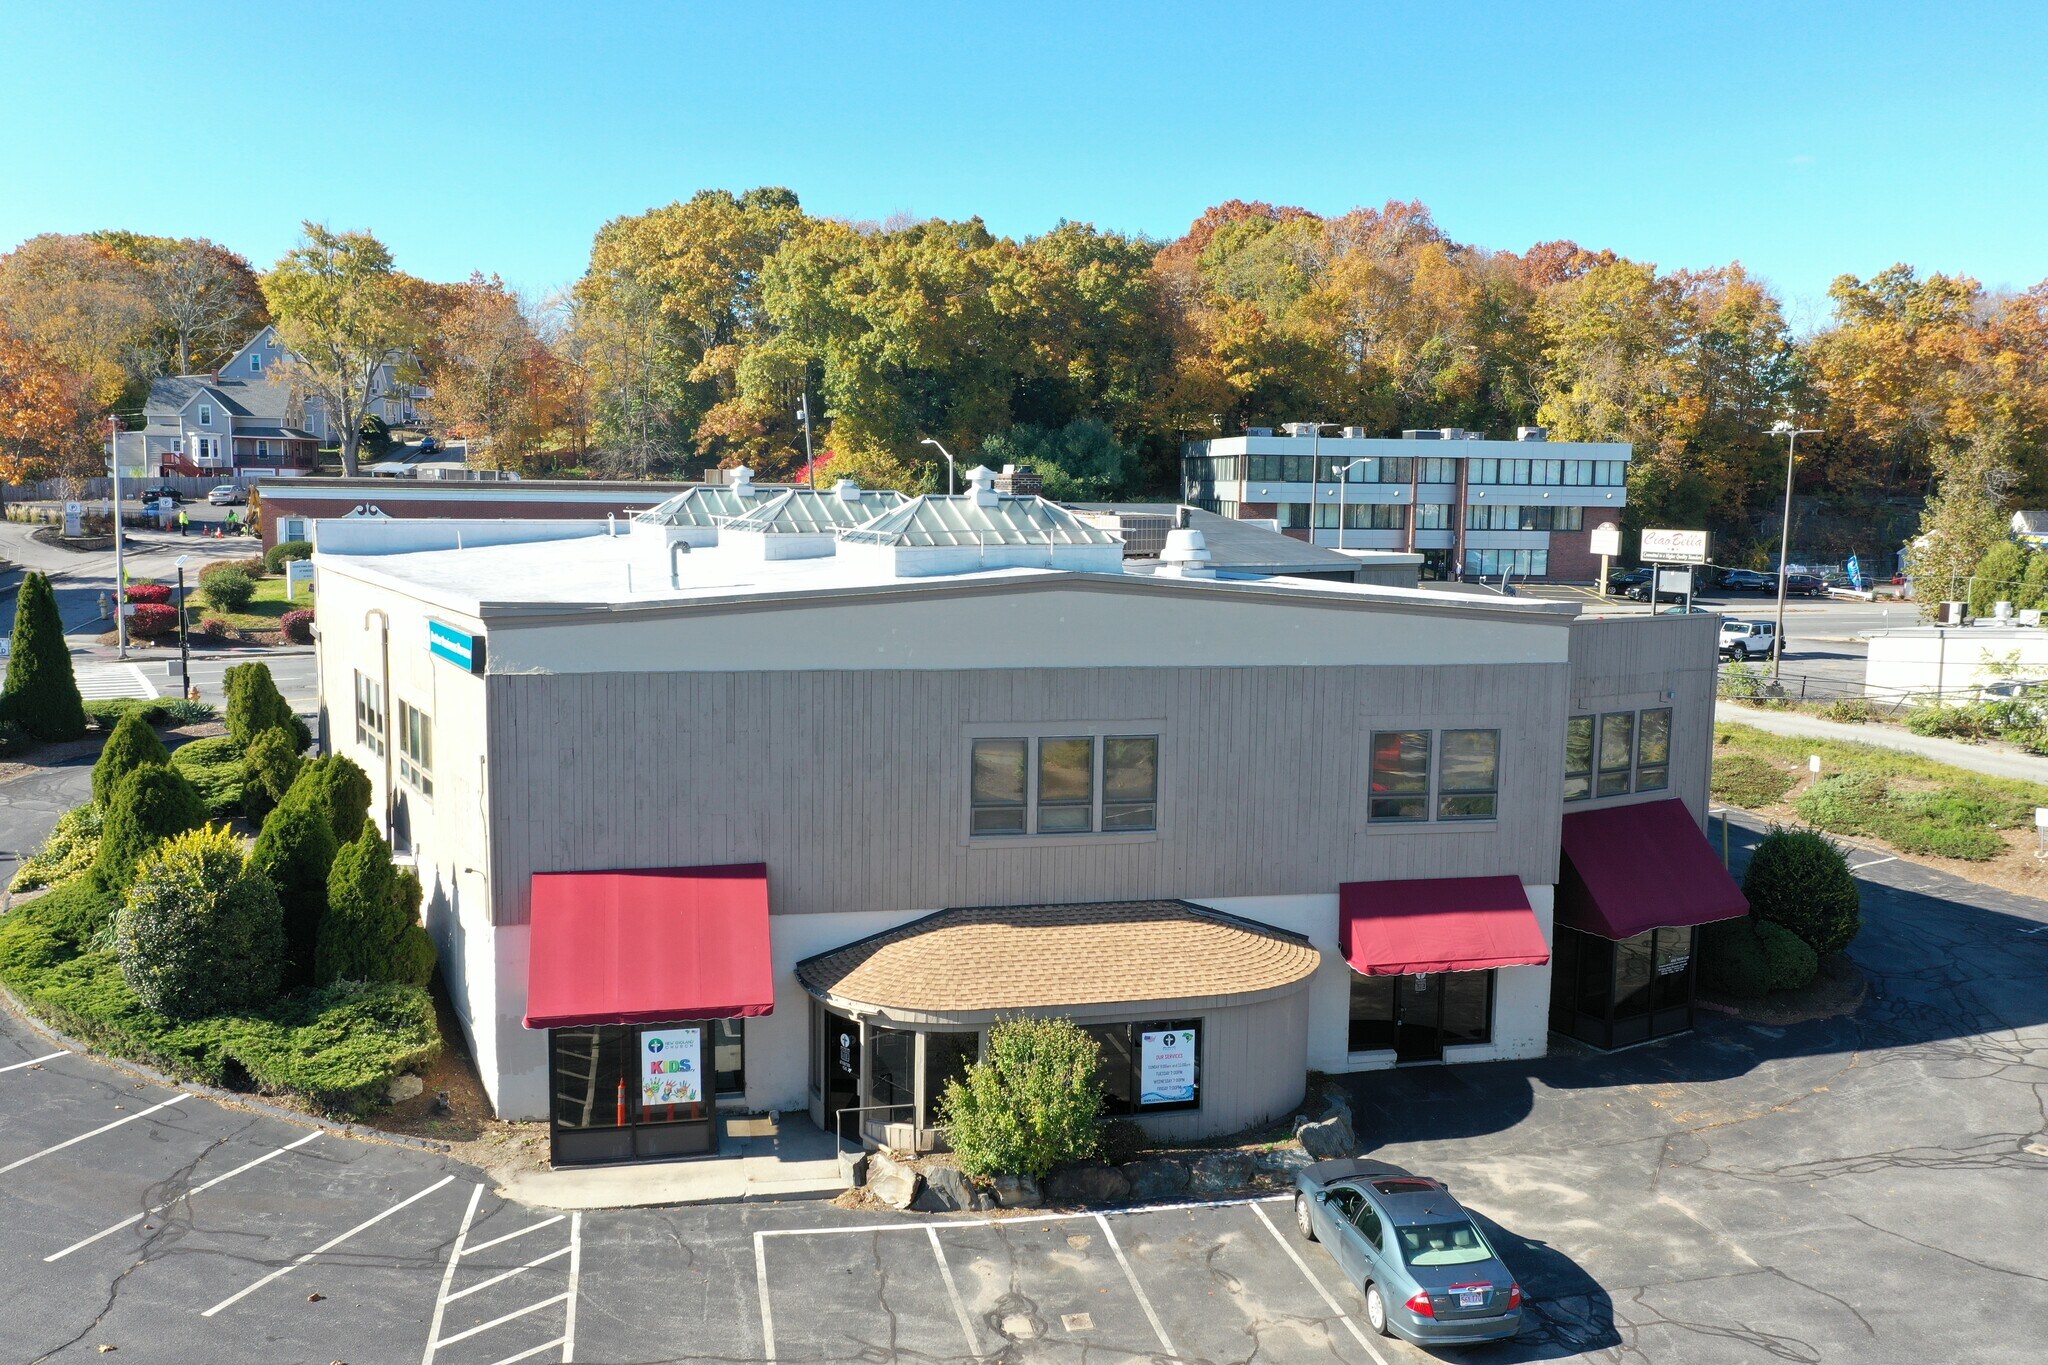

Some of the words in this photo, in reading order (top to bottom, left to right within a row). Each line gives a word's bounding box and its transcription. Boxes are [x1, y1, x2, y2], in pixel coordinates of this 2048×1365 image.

[1644, 531, 1670, 545] Ciao
[1672, 532, 1702, 546] Bella
[650, 1058, 691, 1075] KIDS
